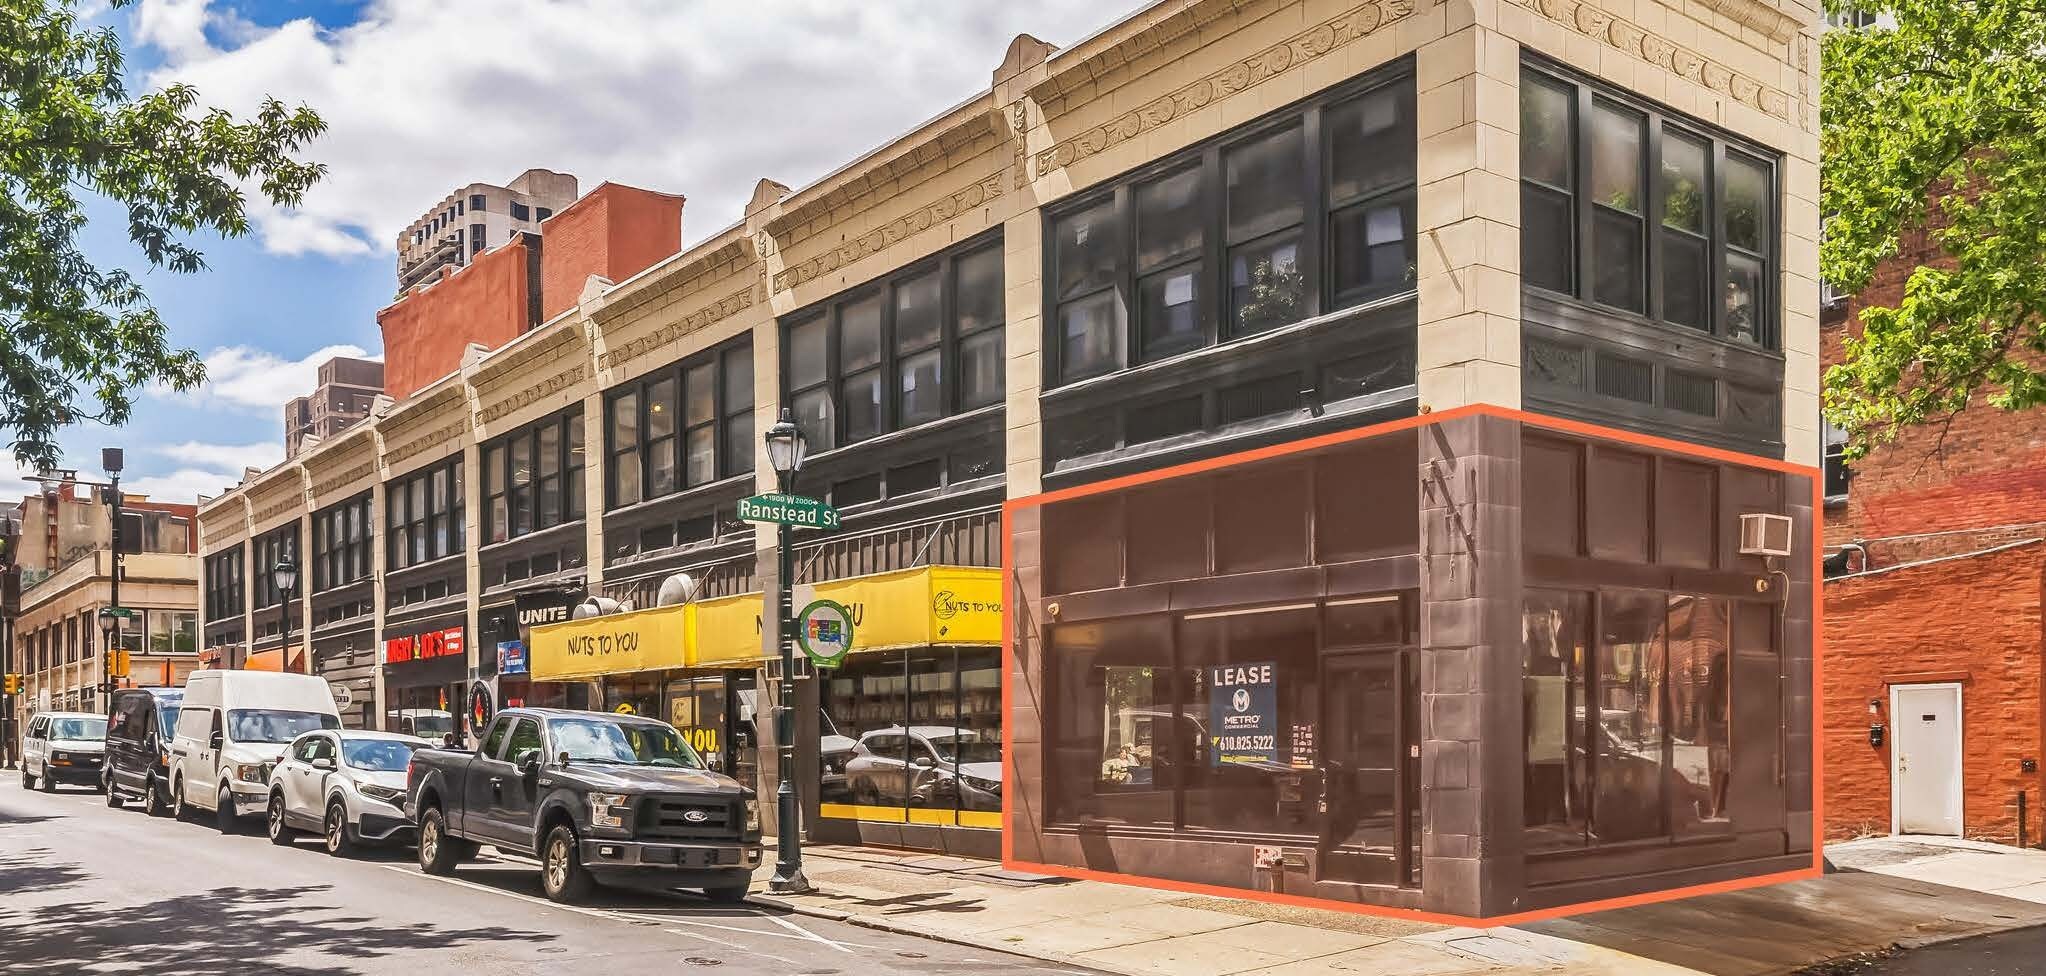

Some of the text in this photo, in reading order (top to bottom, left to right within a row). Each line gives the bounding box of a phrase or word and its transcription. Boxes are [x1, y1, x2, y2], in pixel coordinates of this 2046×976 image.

[787, 496, 795, 505] W
[740, 500, 838, 526] Ranstead St
[519, 605, 567, 625] UNITE
[945, 601, 969, 612] NUTS
[972, 602, 984, 612] TO
[567, 631, 639, 657] NUTS TO YOU
[1214, 665, 1271, 687] LEASE
[1224, 715, 1260, 725] METRO
[1220, 735, 1274, 751] 610.825.5222
